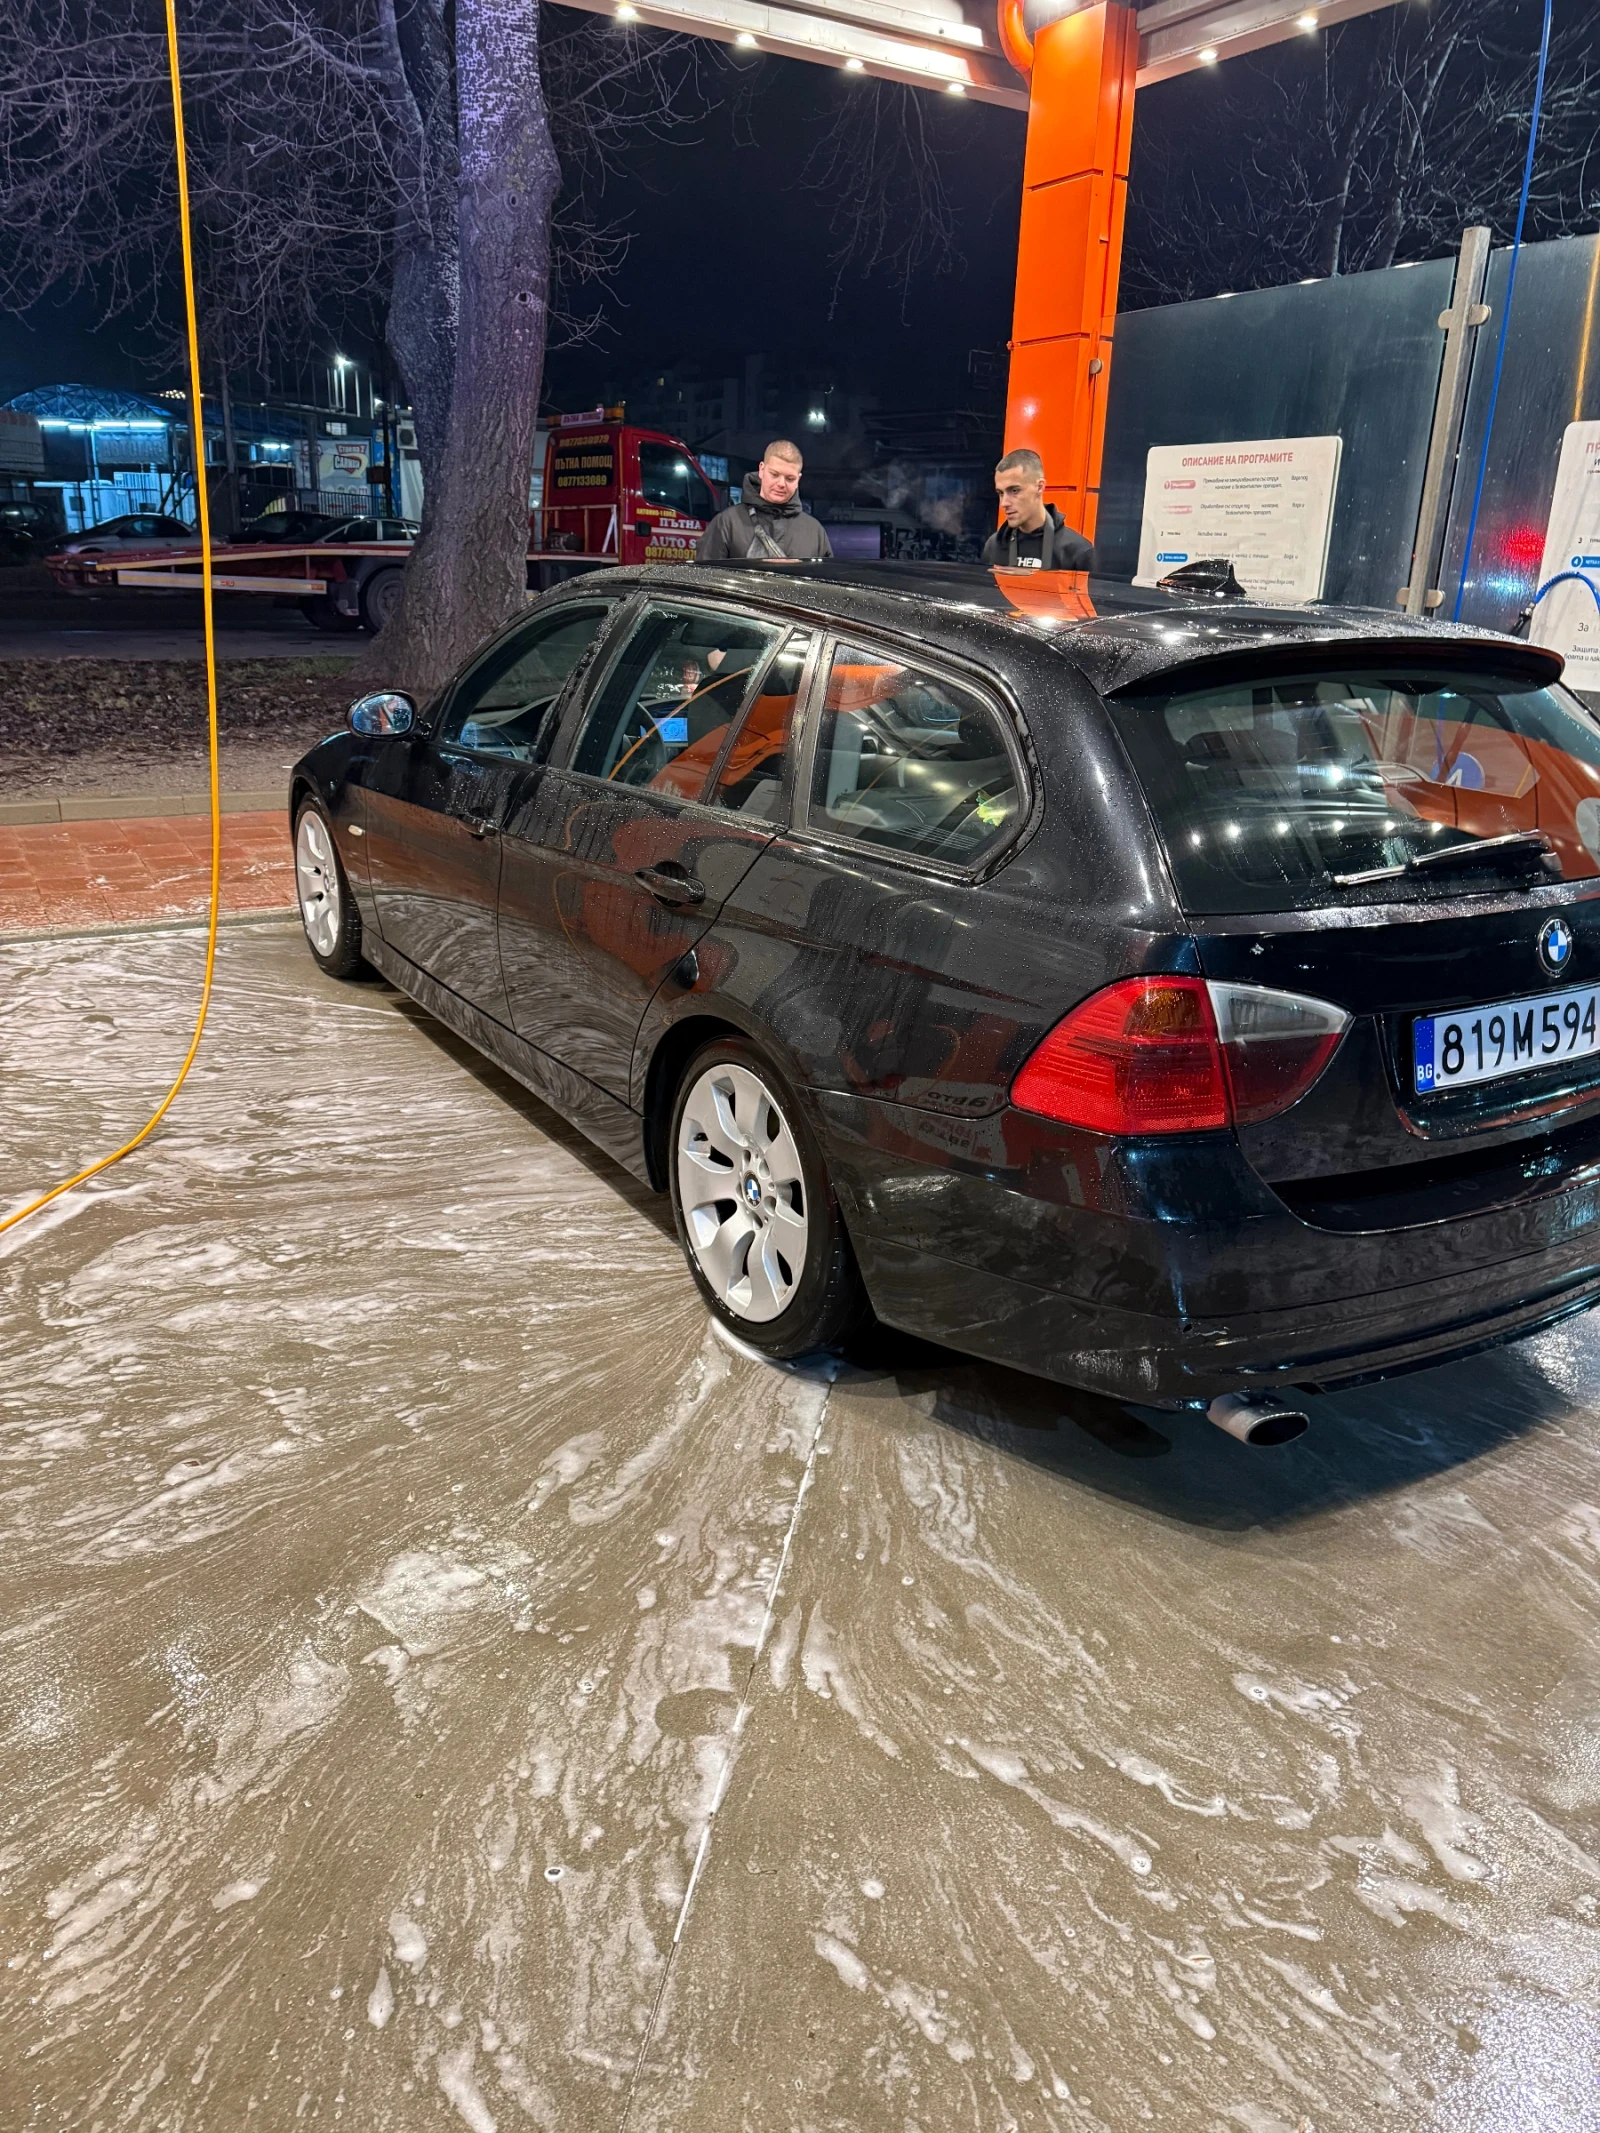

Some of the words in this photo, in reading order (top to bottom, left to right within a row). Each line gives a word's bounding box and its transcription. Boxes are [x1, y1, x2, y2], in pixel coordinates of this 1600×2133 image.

[555, 457, 579, 470] ПЪТНА
[581, 455, 613, 469] ПОМОЩ
[1182, 456, 1224, 467] ОПИСАНИЕ
[1225, 455, 1236, 465] НА
[1238, 452, 1294, 464] ПРОГРАМИТЕ
[659, 517, 703, 530] ПЪТНА
[650, 536, 686, 548] AUTO
[1578, 622, 1589, 632] За
[1572, 645, 1599, 653] Защита
[1441, 996, 1596, 1076] 819M594
[1417, 1064, 1433, 1081] BG
